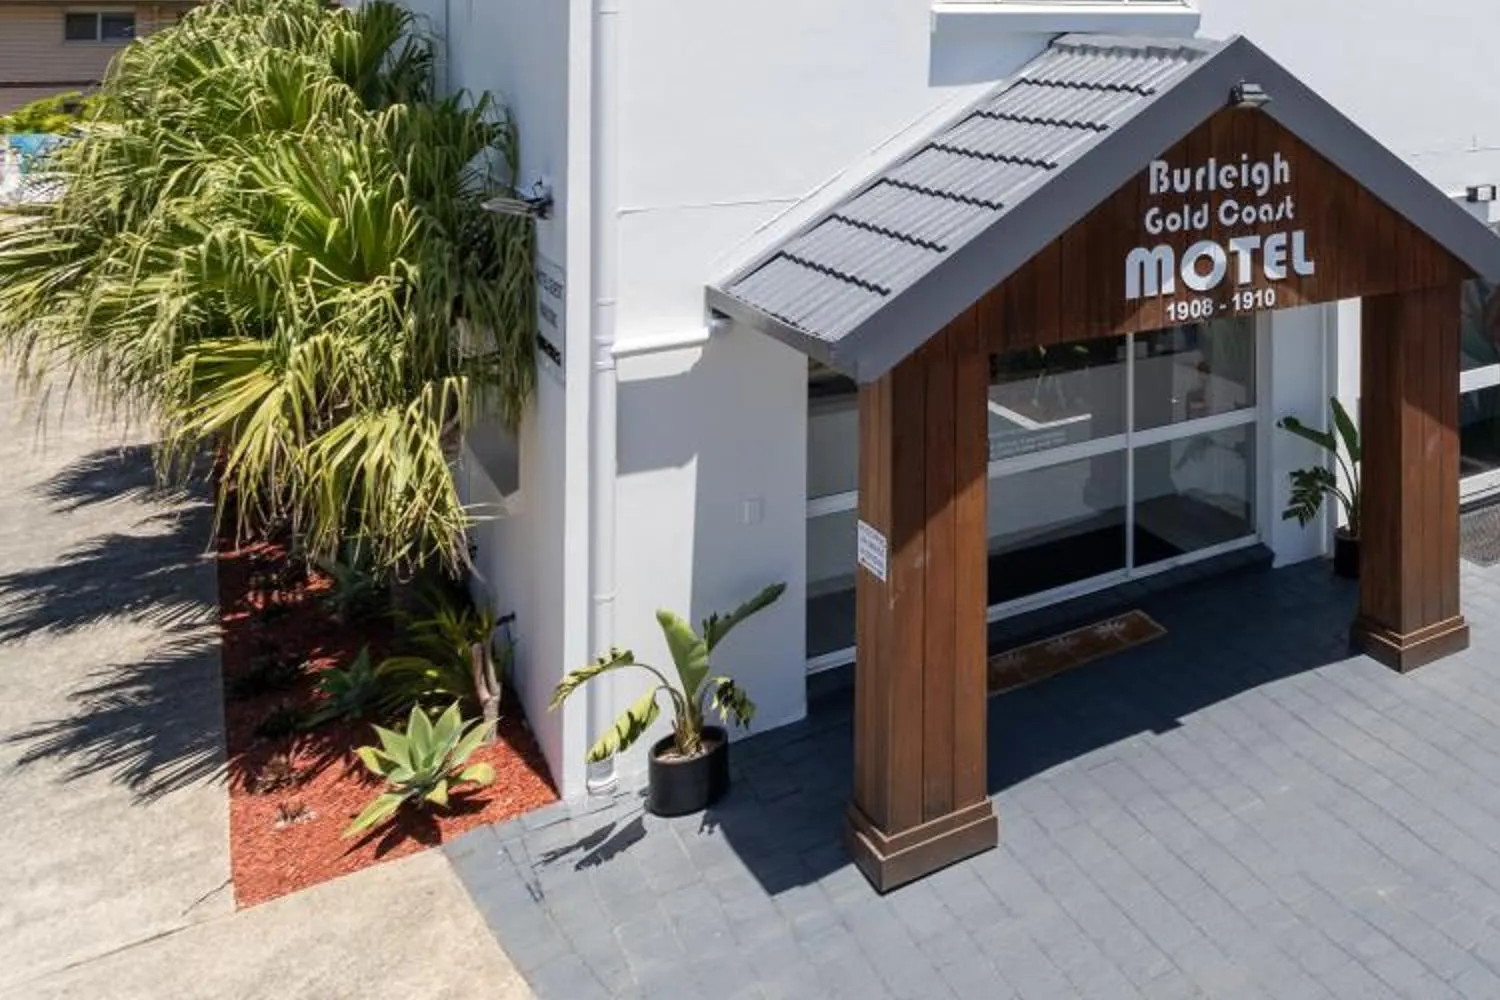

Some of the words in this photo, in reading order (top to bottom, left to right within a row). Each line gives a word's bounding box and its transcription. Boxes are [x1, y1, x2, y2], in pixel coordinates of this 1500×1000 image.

[1149, 151, 1290, 197] Burleigh
[1144, 202, 1209, 235] Gold
[1218, 195, 1296, 226] Coast
[1124, 229, 1315, 300] MOTEL
[1166, 297, 1214, 322] 1908
[1231, 287, 1276, 311] 1910
